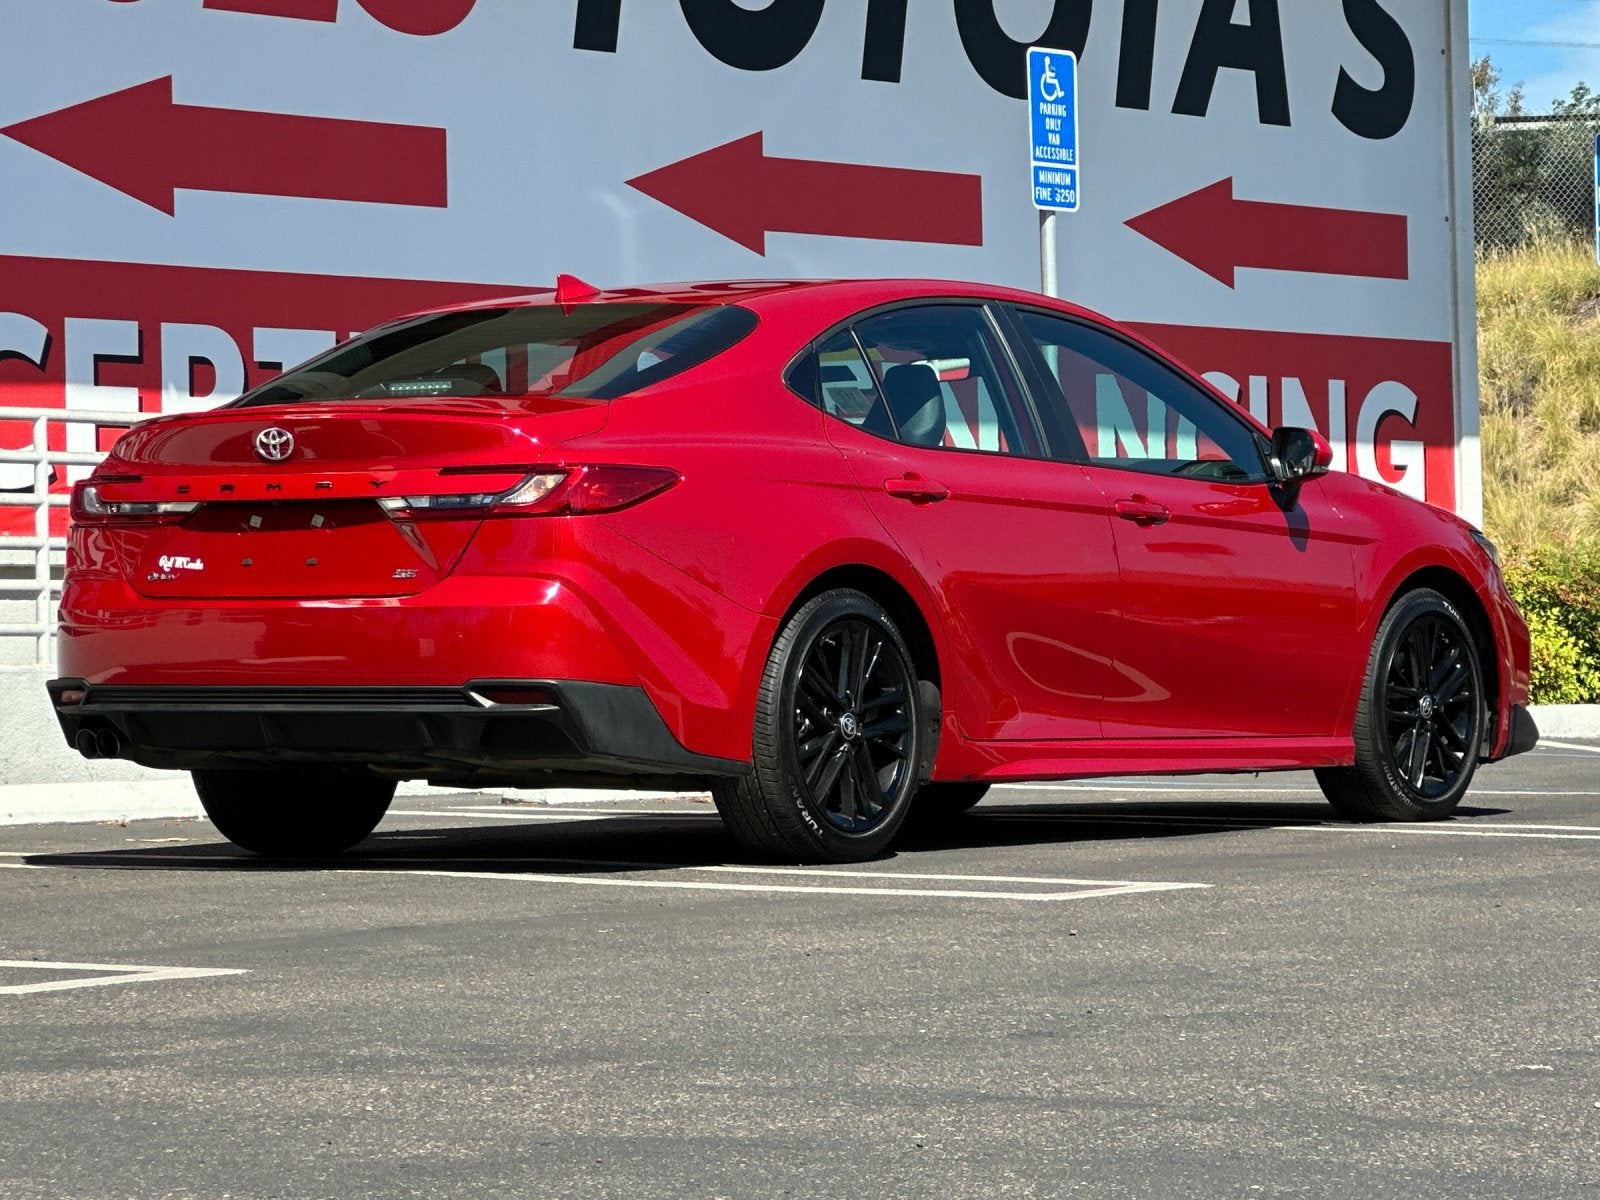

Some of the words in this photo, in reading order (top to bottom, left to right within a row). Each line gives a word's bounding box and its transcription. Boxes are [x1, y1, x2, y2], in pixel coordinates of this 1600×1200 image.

[1039, 102, 1067, 117] PARKING
[1045, 117, 1061, 131] ONLY
[1048, 133, 1061, 146] VAN
[1035, 146, 1074, 162] ACCESSIBLE
[1039, 169, 1071, 186] MINIMUM
[1035, 186, 1053, 201] FINE
